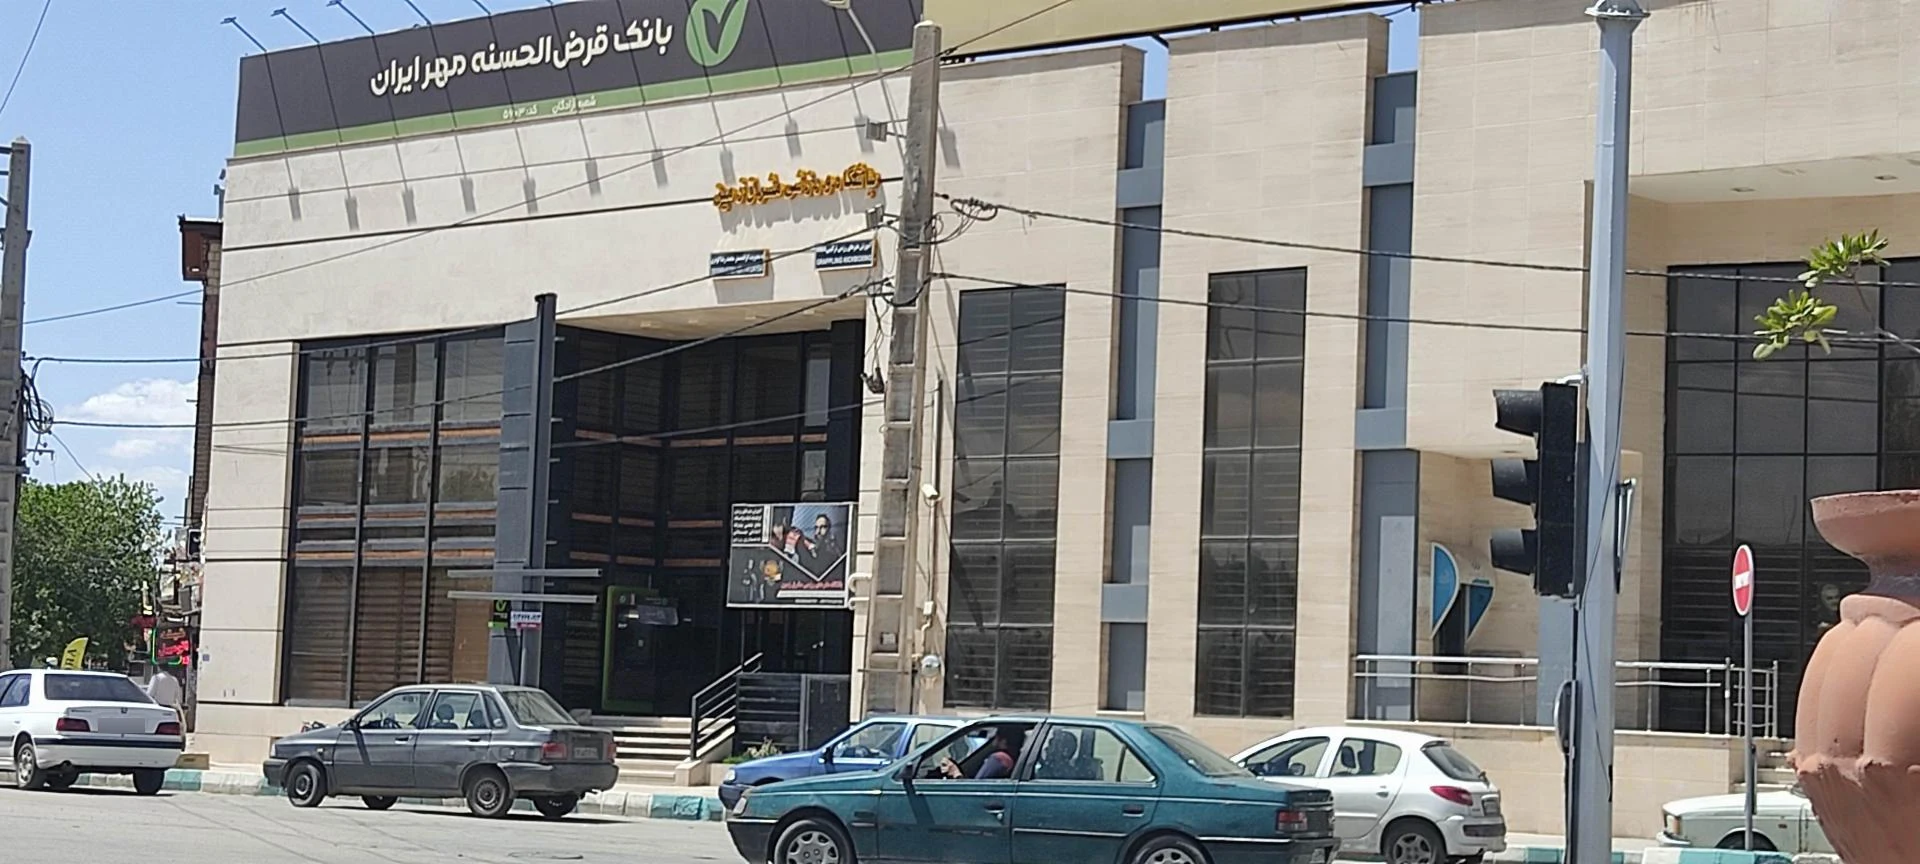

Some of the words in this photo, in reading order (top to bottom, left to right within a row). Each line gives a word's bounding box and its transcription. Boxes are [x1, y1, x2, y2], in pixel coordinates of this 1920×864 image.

[613, 17, 673, 55] بانک
[370, 55, 420, 96] ایران
[420, 54, 466, 90] مهر
